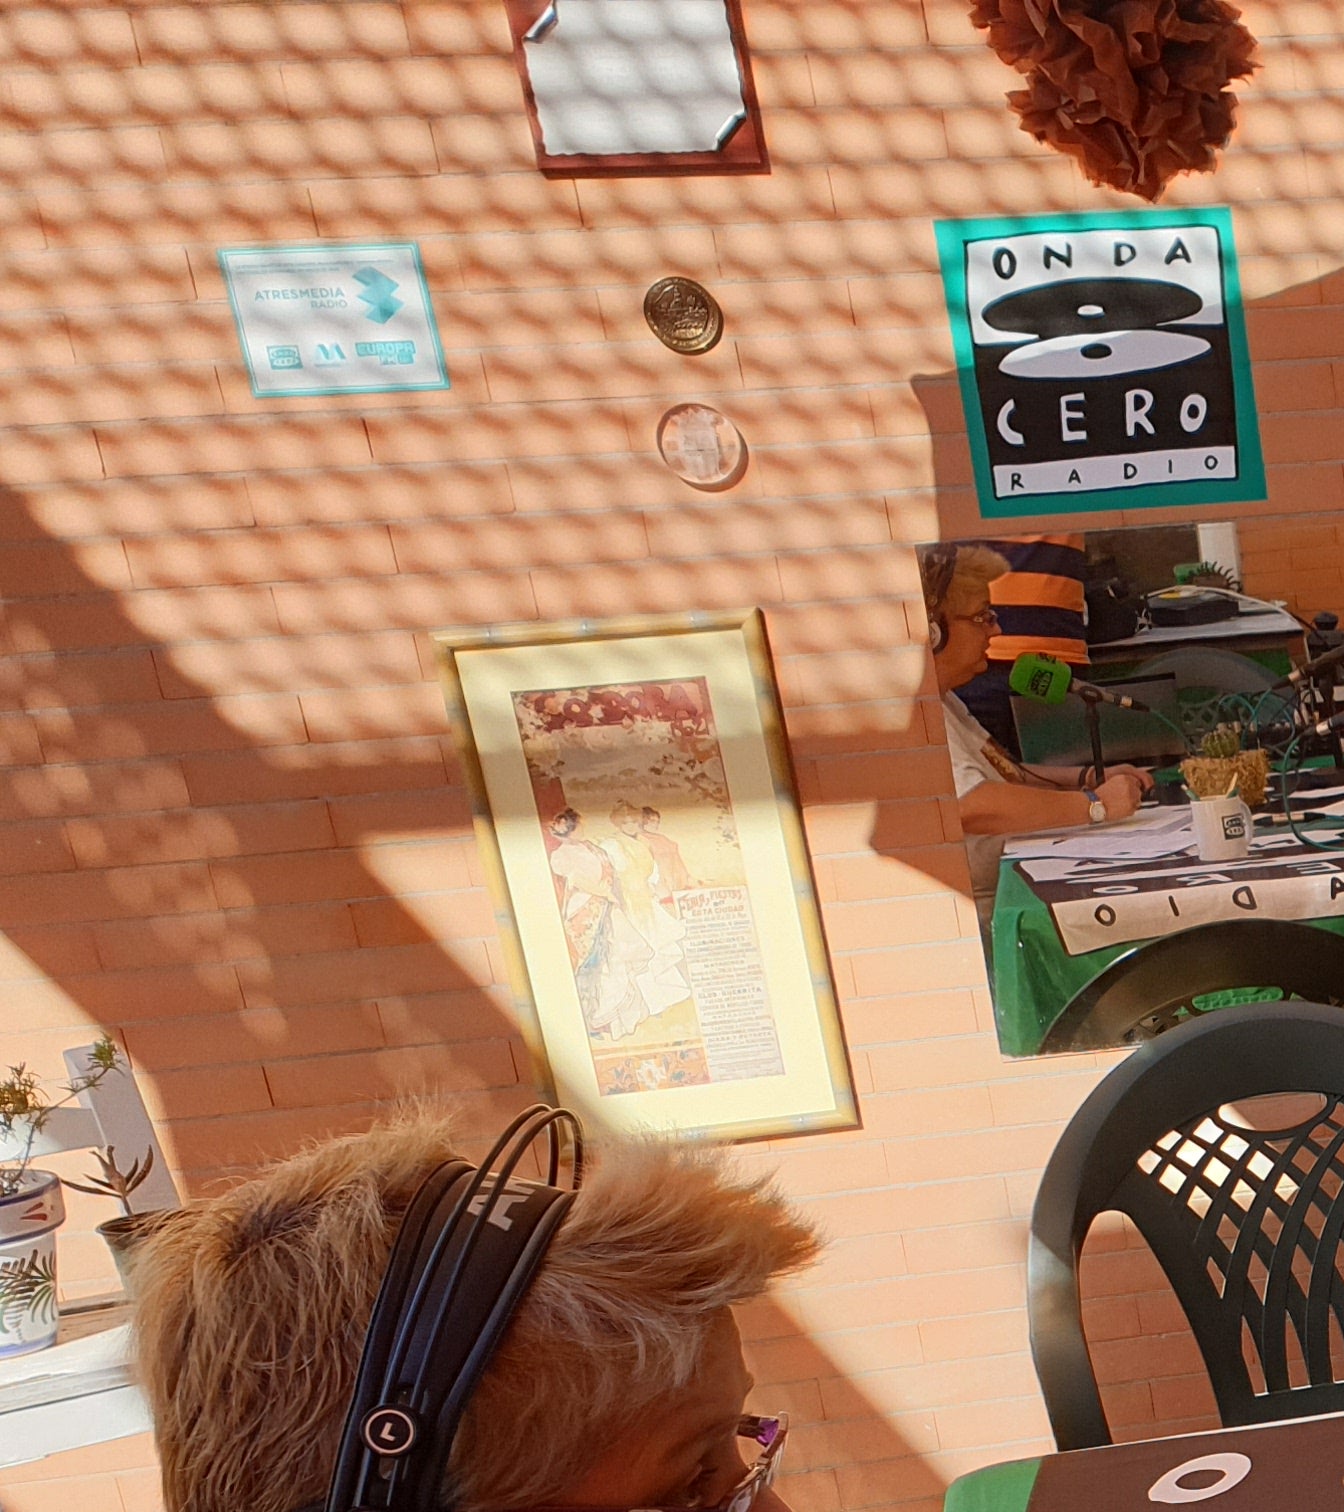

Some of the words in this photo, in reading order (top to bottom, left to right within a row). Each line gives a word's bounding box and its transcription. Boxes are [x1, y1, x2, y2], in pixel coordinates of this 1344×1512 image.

[993, 236, 1192, 280] ONDA
[254, 287, 346, 302] ATRESMEDIA
[310, 300, 348, 309] RADIO
[996, 389, 1208, 447] CERO
[1010, 454, 1219, 491] RADIO
[380, 1421, 396, 1442] L
